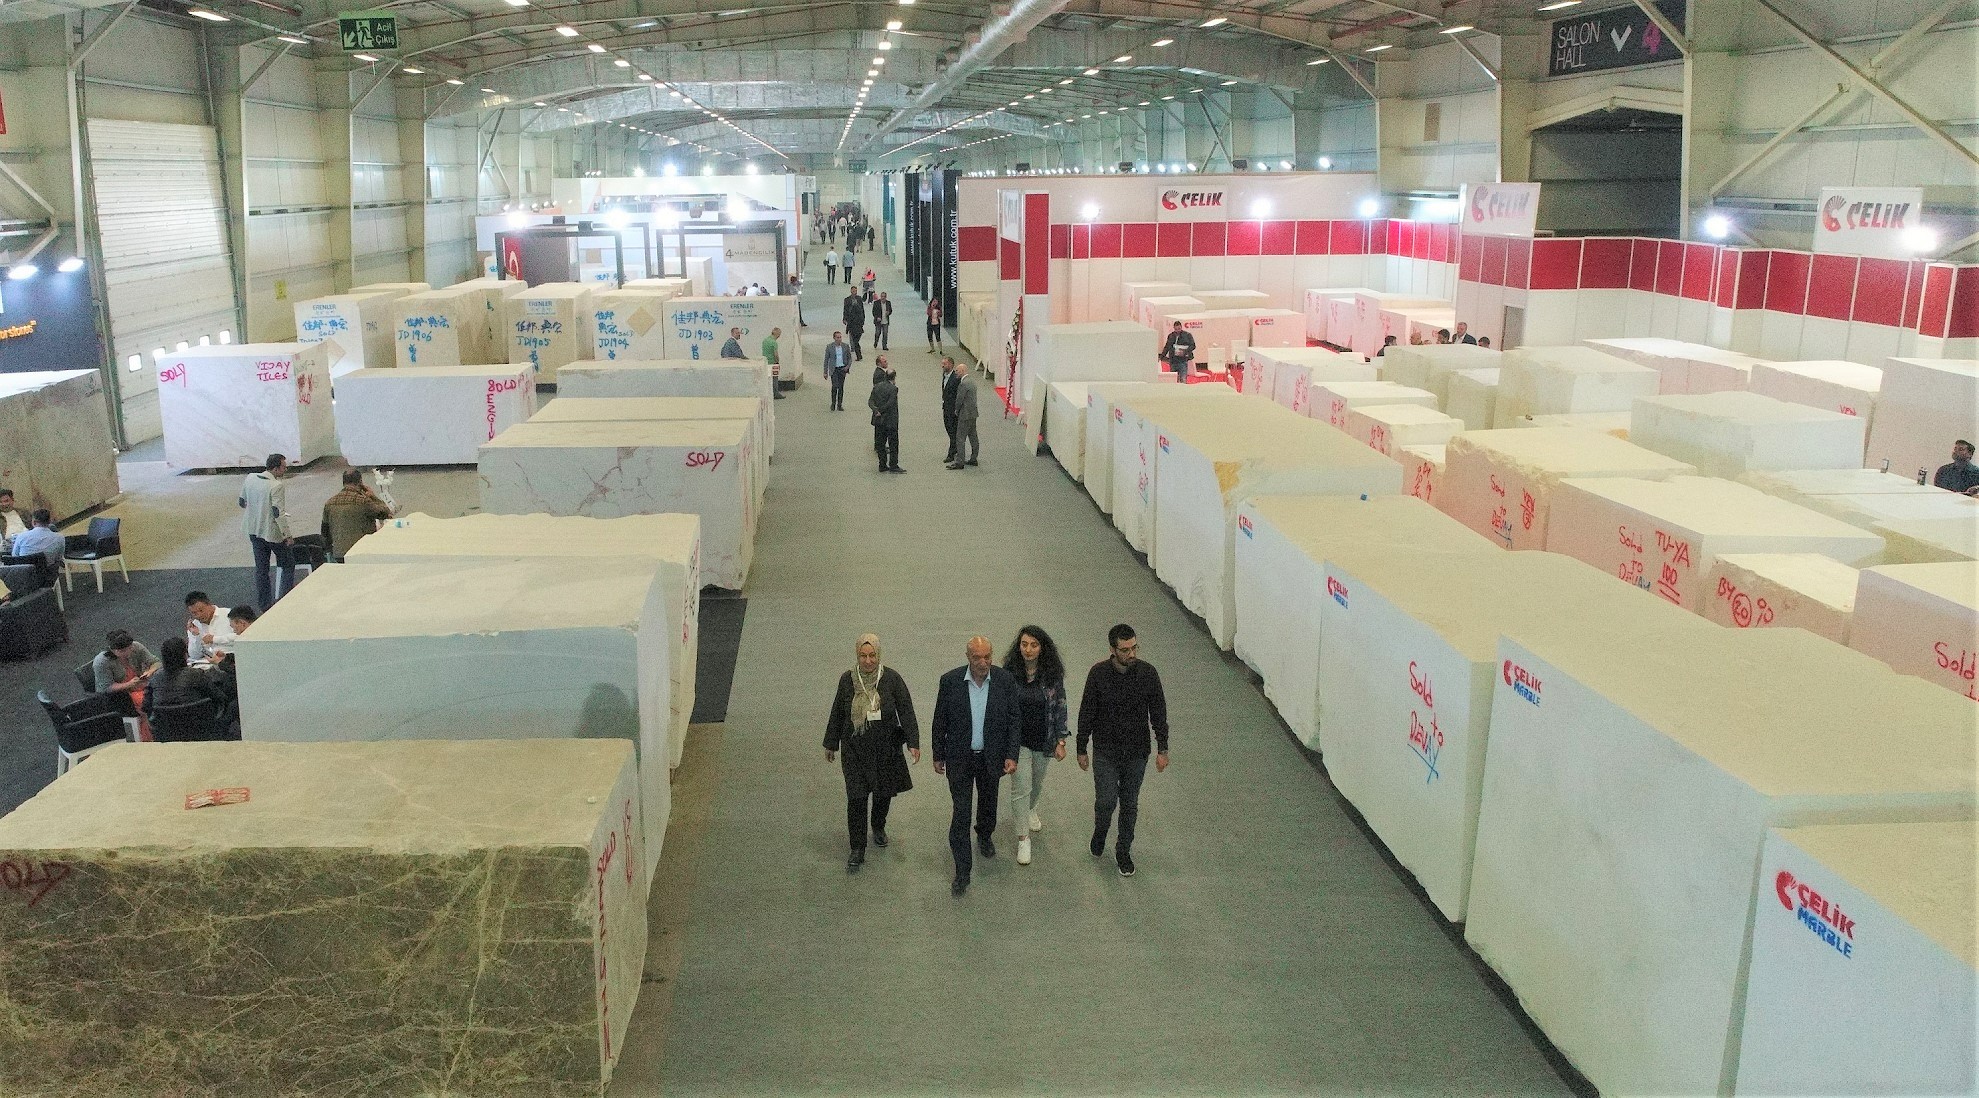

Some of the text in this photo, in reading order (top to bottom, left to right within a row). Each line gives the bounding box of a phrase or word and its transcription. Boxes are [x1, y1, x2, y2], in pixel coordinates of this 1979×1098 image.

[376, 23, 392, 31] Acil
[1557, 21, 1600, 49] SALON
[1555, 45, 1586, 70] HALL
[949, 209, 958, 289] www.kutuk.com.tr
[160, 363, 186, 388] SOLD
[257, 372, 288, 381] TILES
[488, 379, 516, 393] SOLD
[686, 452, 725, 472] SOLD
[1934, 641, 1976, 680] Sold
[1409, 661, 1432, 708] Sold
[1514, 665, 1542, 694] ÇELİK
[1513, 681, 1541, 707] MARBLE
[1797, 884, 1856, 940] ÇELİK
[1797, 907, 1852, 960] MARBLE
